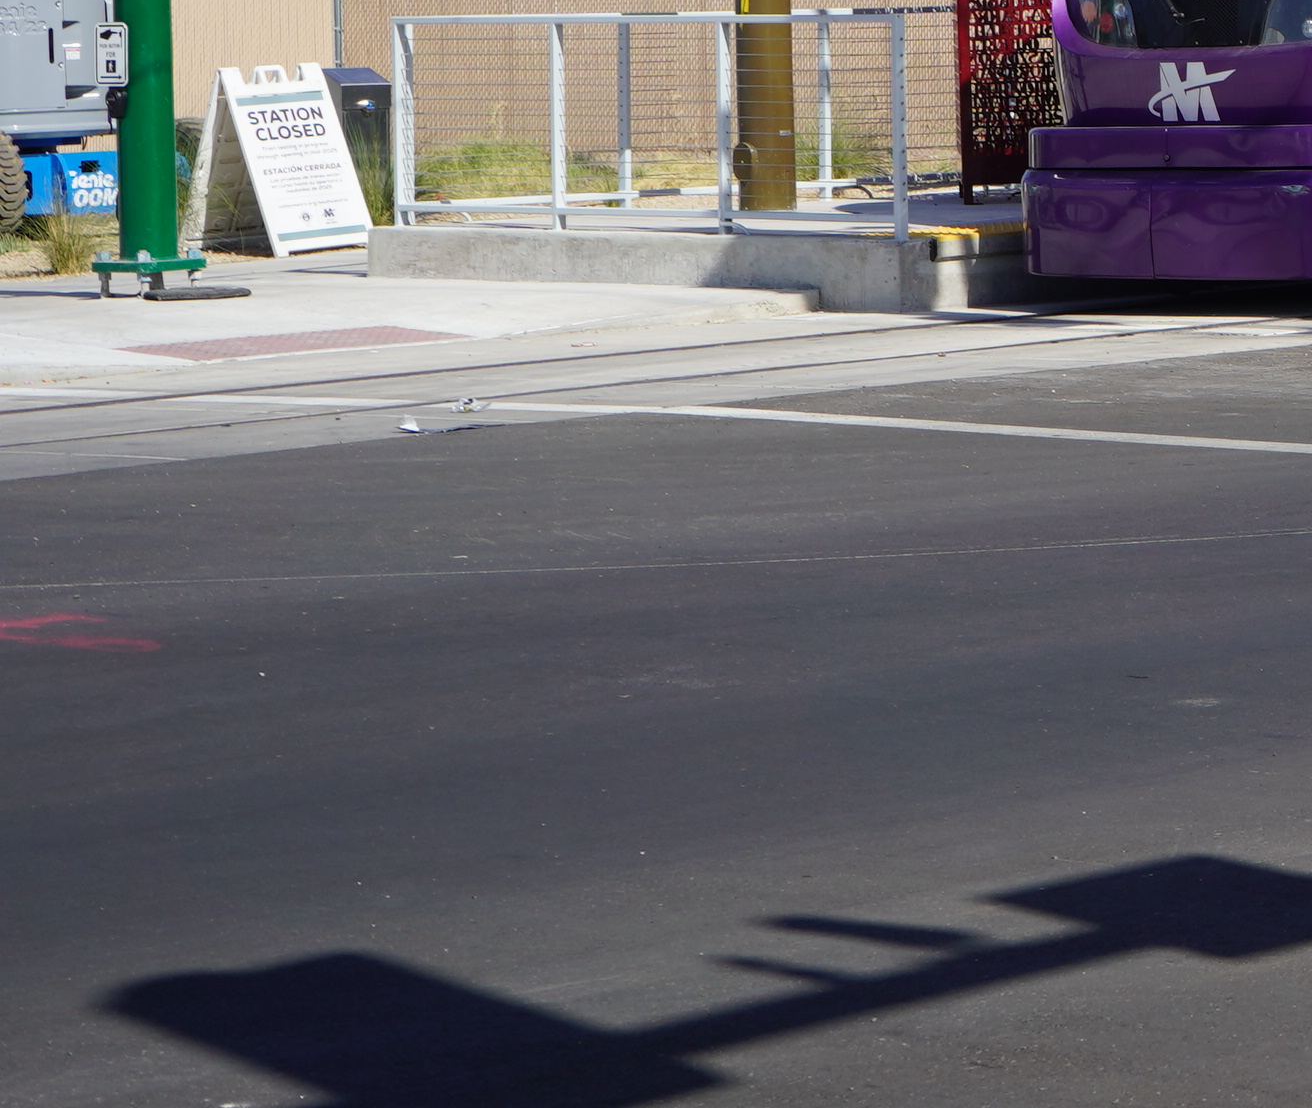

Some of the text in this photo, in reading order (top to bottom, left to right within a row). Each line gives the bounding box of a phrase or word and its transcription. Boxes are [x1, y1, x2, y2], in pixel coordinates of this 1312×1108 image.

[248, 106, 323, 125] STATION
[256, 123, 326, 141] CLOSED
[263, 162, 342, 176] ESTACIÓN CERRADA
